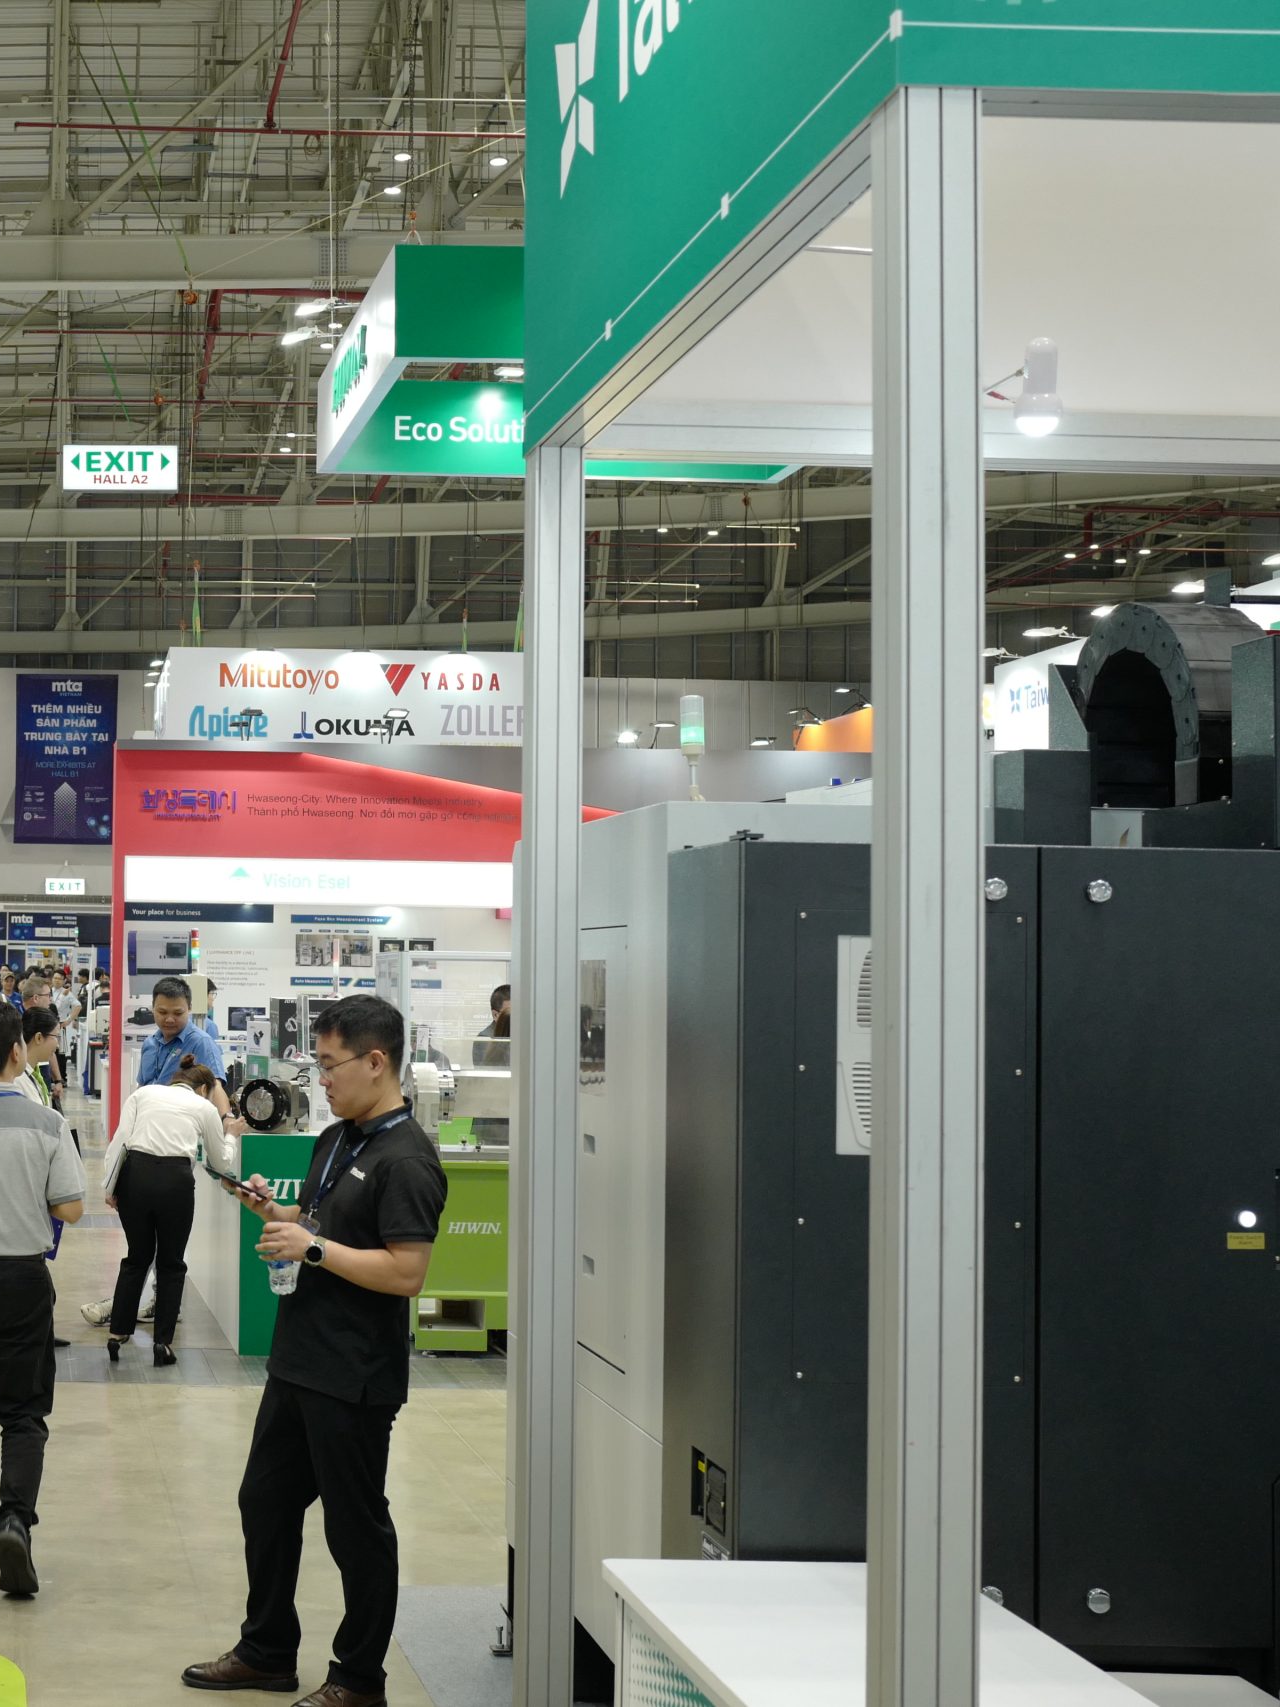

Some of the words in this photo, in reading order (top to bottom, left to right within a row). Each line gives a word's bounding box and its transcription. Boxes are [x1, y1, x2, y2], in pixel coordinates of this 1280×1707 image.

[394, 416, 443, 441] Eco
[86, 451, 154, 472] EXIT
[93, 474, 127, 484] HALL
[131, 474, 148, 484] A2
[220, 663, 339, 695] Mitutoyo
[421, 672, 500, 691] YASDA
[52, 680, 82, 692] mta
[32, 703, 63, 714] THÊM
[24, 732, 61, 741] TRUNG
[91, 732, 109, 742] TẠI
[73, 746, 87, 755] B1
[326, 795, 357, 804] Where
[361, 795, 410, 805] Innovation
[247, 807, 277, 816] Thành
[281, 805, 299, 819] phố
[49, 882, 81, 891] EXIT
[263, 873, 311, 888] Vision
[319, 874, 350, 889] Esel
[148, 909, 165, 917] place
[11, 915, 34, 924] mta
[448, 1222, 500, 1235] HIWIN
